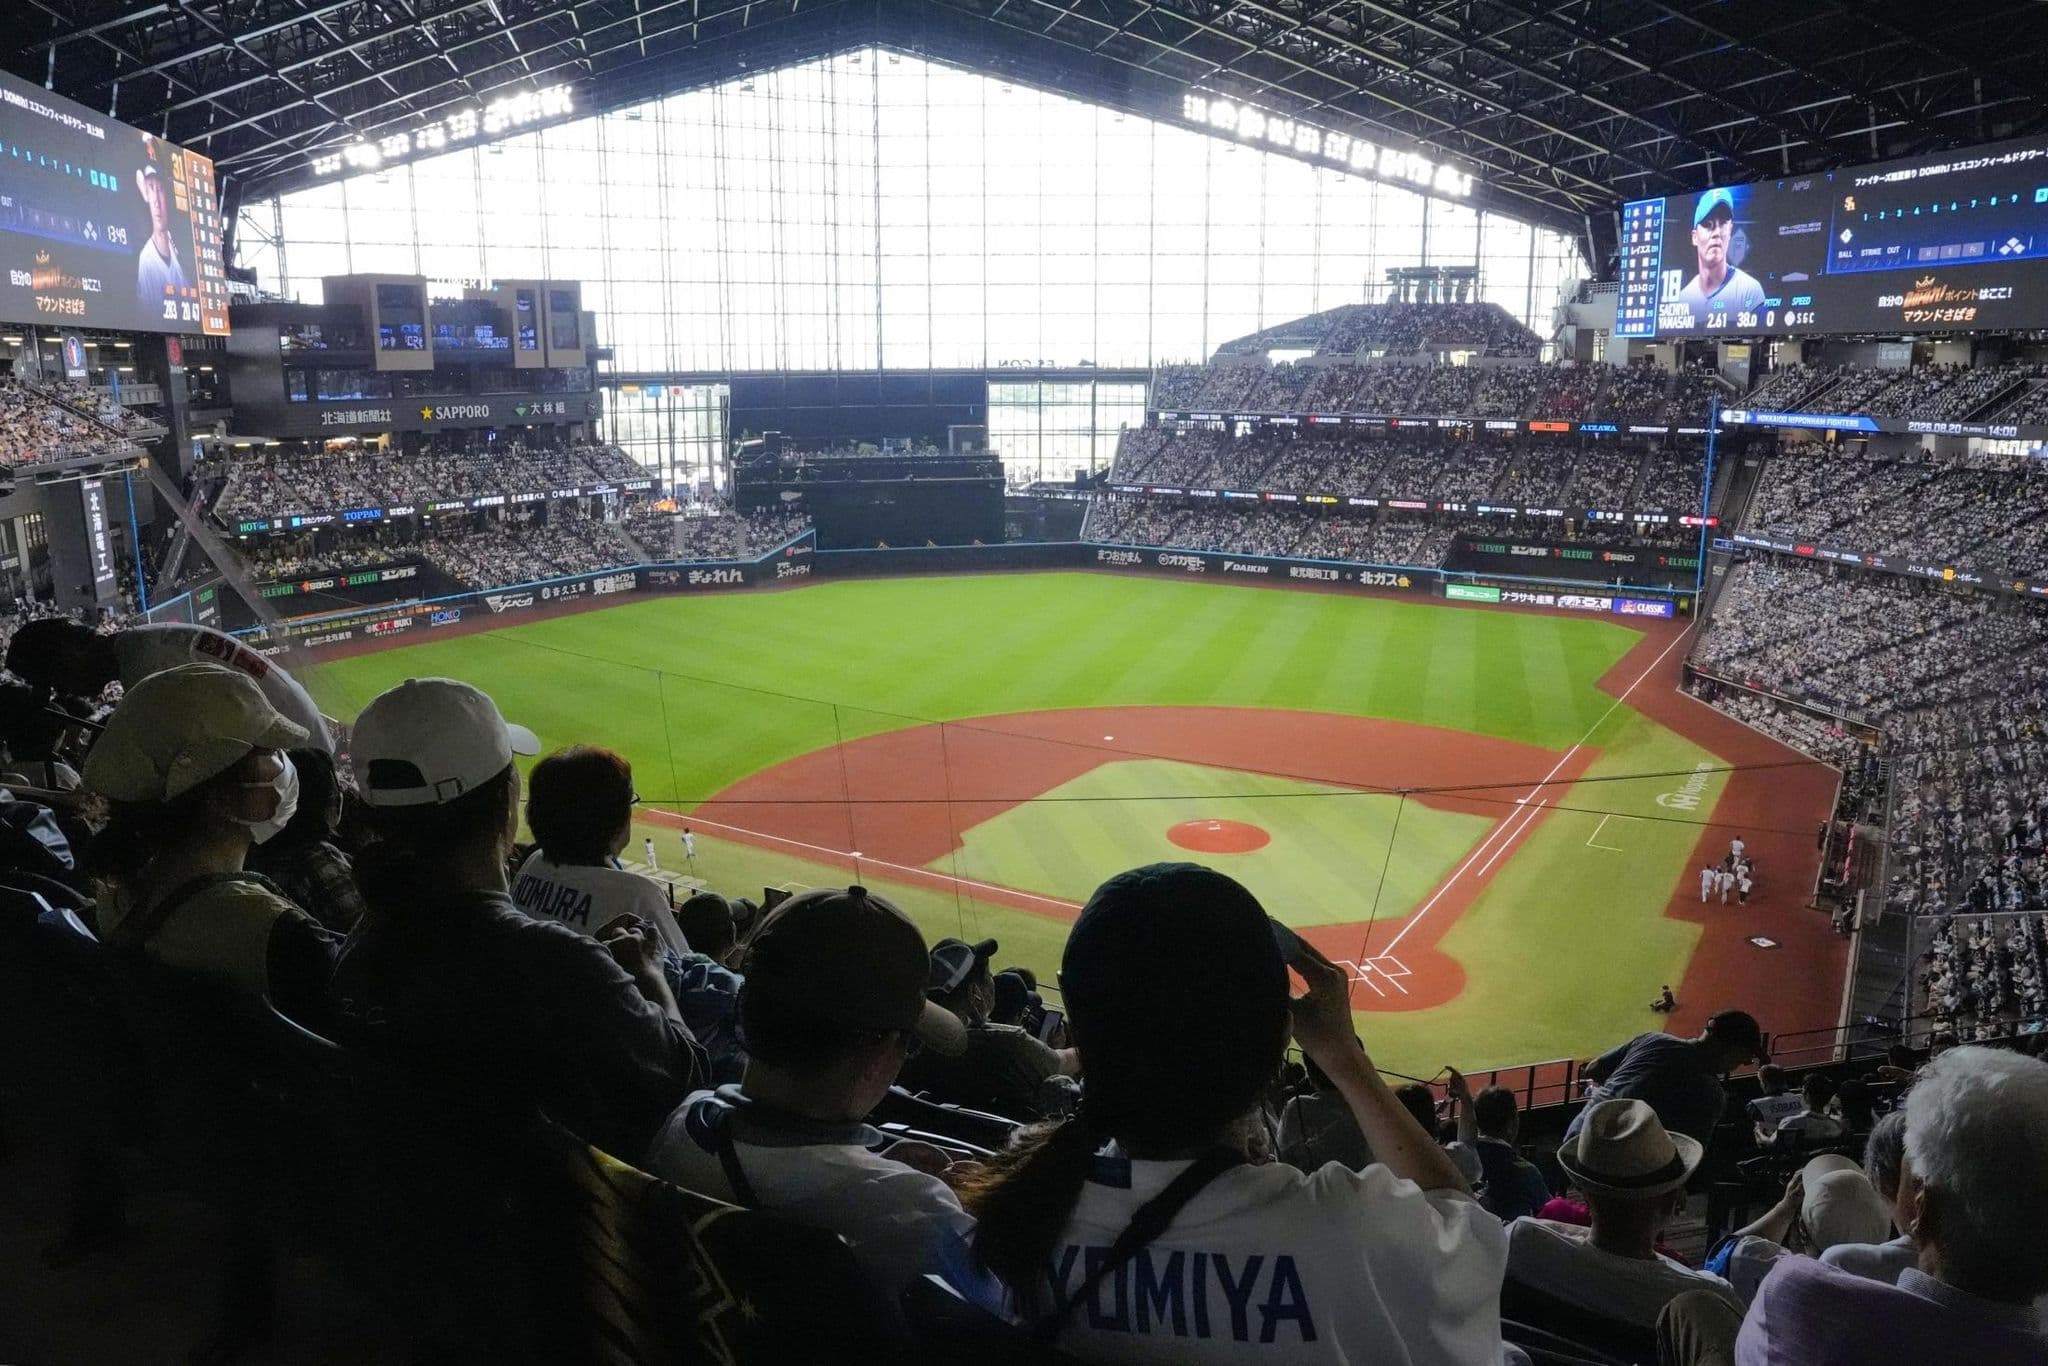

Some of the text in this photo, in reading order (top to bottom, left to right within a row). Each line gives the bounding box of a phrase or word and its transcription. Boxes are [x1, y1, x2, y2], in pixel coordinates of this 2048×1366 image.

[1661, 270, 1682, 303] 18
[36, 295, 86, 316] マウンドさばき
[1792, 296, 1812, 305] SPEED
[1706, 313, 1728, 328] 2.61
[1737, 312, 1758, 327] 38.0
[1766, 311, 1775, 327] 0
[1903, 307, 1977, 323] マウンドさばき
[435, 405, 490, 421] SAPPORO
[530, 402, 566, 415] 大林組
[321, 409, 392, 426] 北海道新聞社
[1908, 421, 1962, 434] 2026.08.20
[1988, 425, 2018, 437] 14:00
[344, 509, 382, 521] TOPPAN
[1168, 555, 1206, 567] オカモト
[1233, 564, 1269, 574] DAIKIN
[688, 568, 744, 585] ぎょれん
[1360, 571, 1398, 587] 北ガス
[1501, 591, 1555, 606] ナラサキ産業
[1637, 602, 1666, 614] CLASSIC
